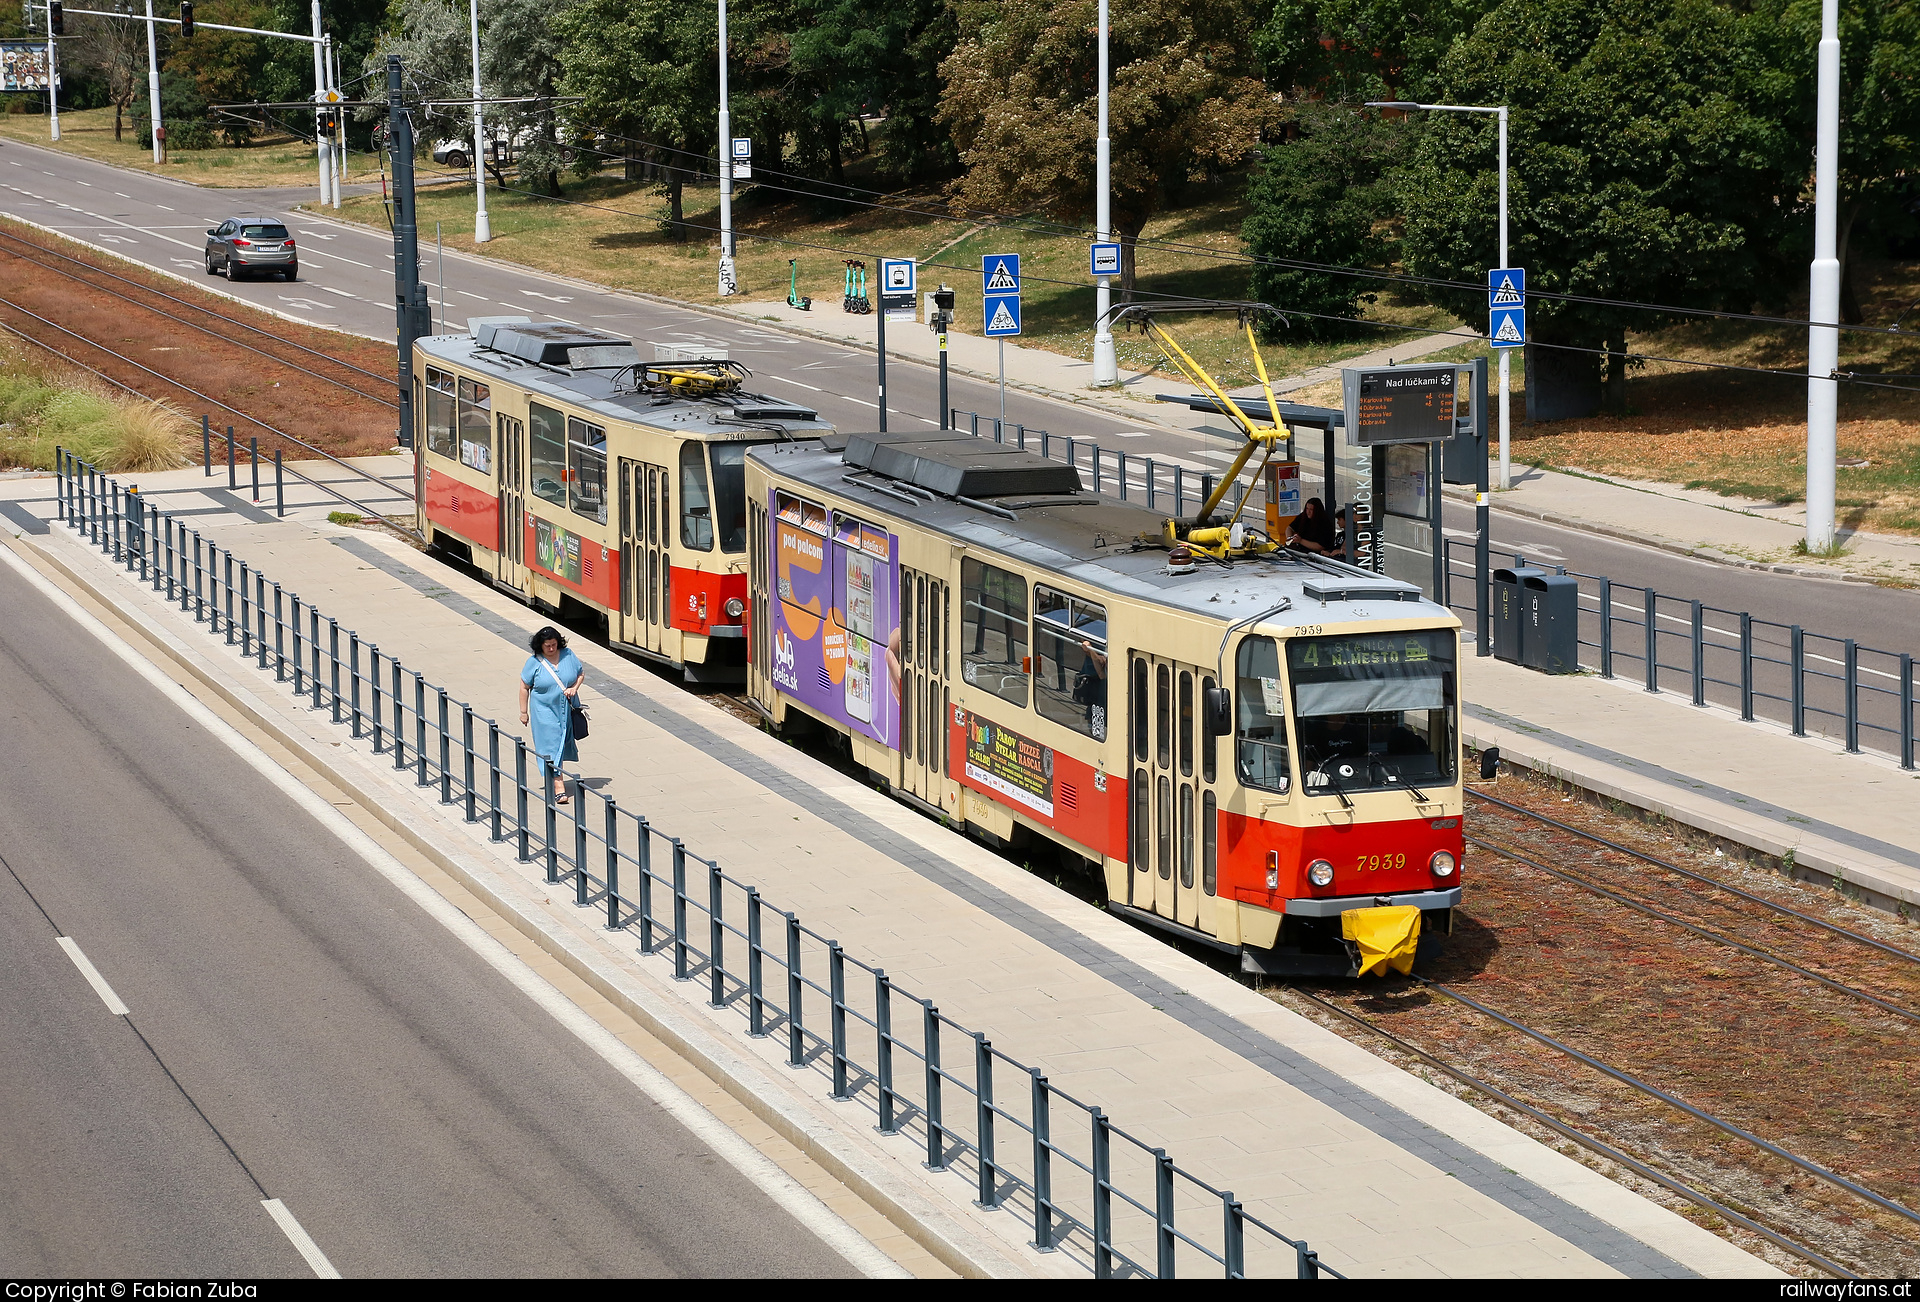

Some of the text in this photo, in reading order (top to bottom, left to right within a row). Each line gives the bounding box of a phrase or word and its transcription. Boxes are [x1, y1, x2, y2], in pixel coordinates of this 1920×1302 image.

[940, 338, 946, 346] P
[1386, 379, 1402, 387] Nad
[1405, 377, 1438, 387] lúčkami
[726, 433, 745, 441] 7940
[783, 533, 823, 560] pod palcom
[1357, 532, 1372, 566] NAD
[1376, 530, 1385, 573] ZASTÁVKA
[1295, 625, 1322, 636] 7939
[830, 648, 833, 659] 2
[1304, 643, 1319, 666] 4
[996, 727, 1016, 748] PAROV
[995, 741, 1018, 763] STELAR
[1018, 741, 1041, 759] DIZZEE
[1018, 754, 1042, 772] RASCAL
[1357, 853, 1406, 872] 7939
